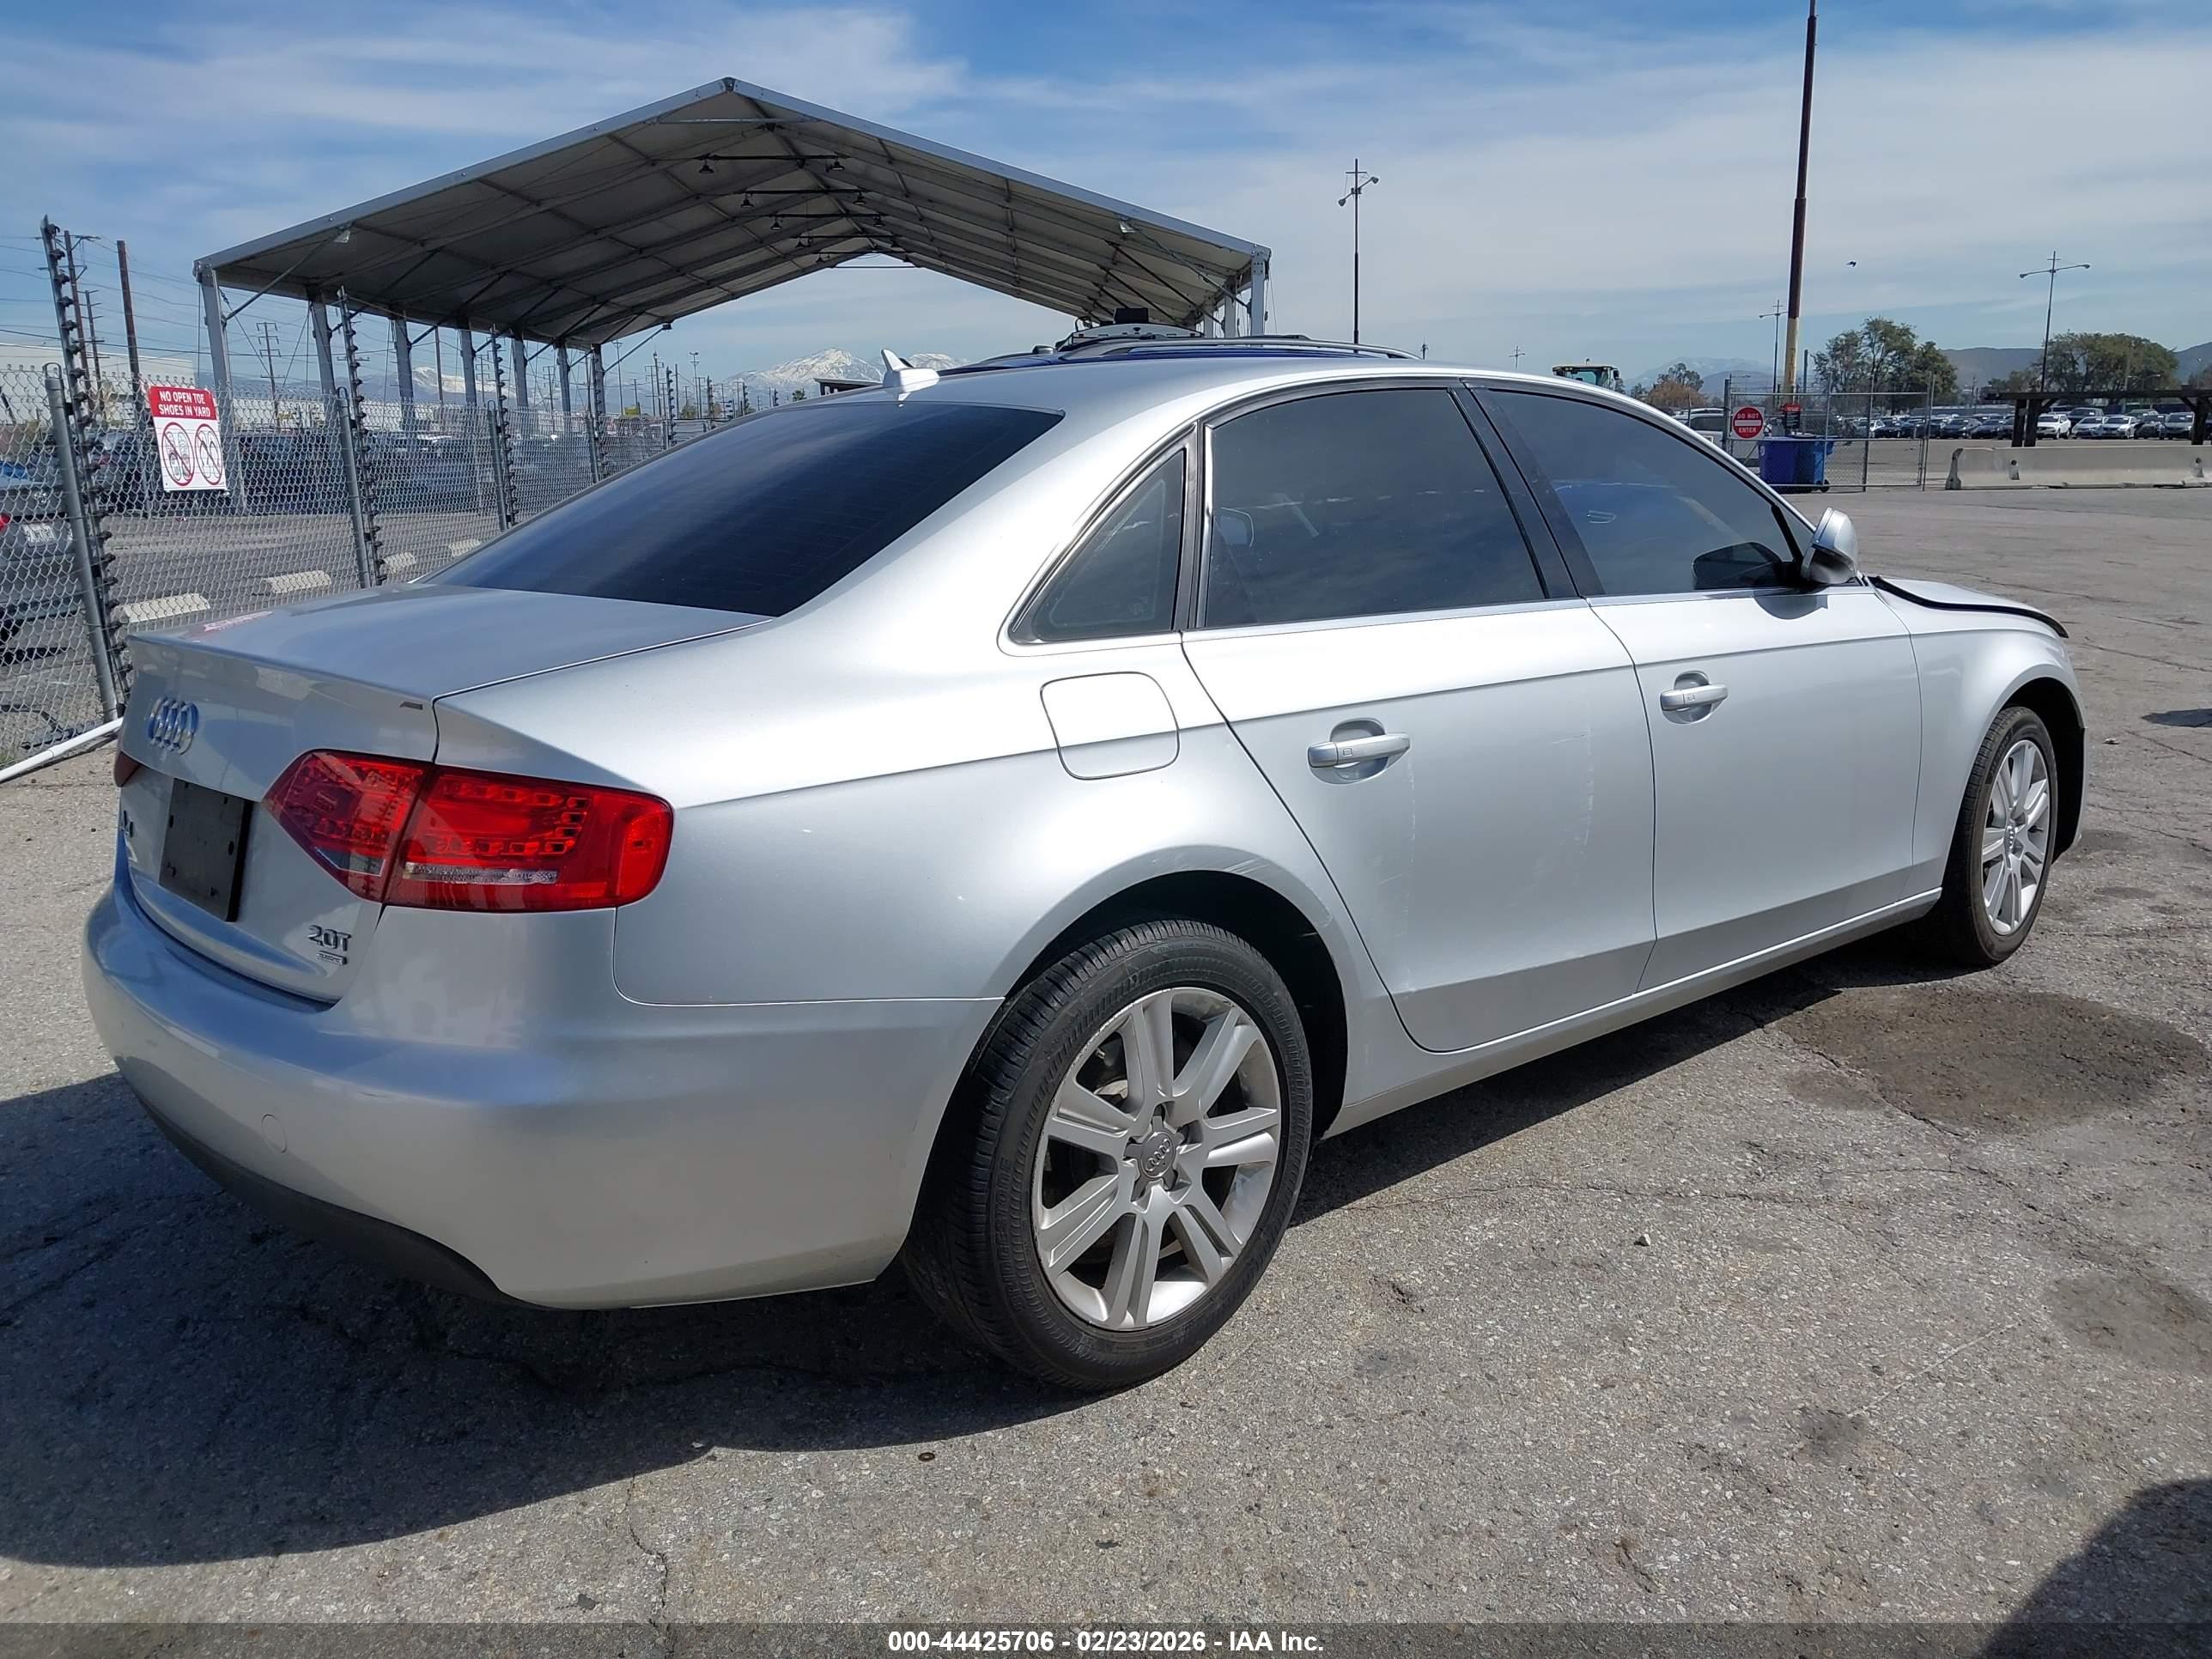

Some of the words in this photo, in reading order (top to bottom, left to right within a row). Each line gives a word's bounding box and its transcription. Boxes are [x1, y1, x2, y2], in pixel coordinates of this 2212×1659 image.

[159, 391, 172, 402] NO
[173, 392, 191, 404] OPEN
[192, 393, 205, 404] TOE
[158, 404, 184, 416] SHOES
[185, 406, 193, 416] IN
[194, 407, 211, 417] YARD
